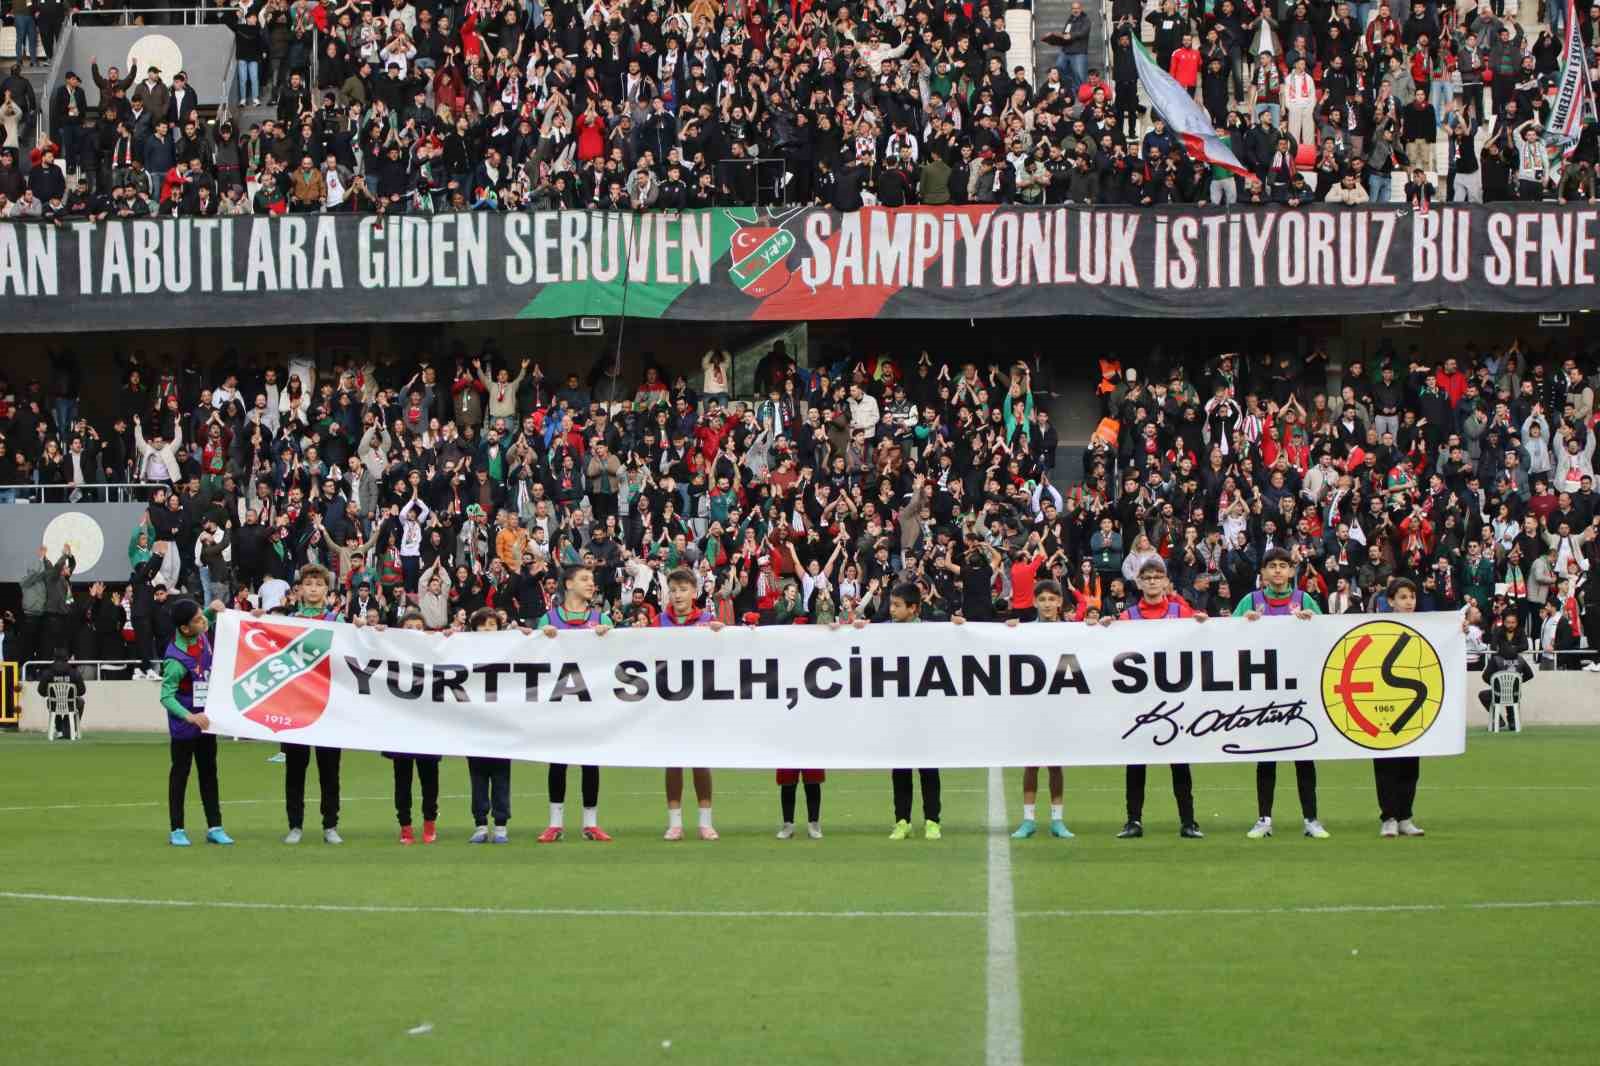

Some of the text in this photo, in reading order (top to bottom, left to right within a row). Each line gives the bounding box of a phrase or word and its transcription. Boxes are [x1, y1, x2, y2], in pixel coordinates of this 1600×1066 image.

[0, 222, 58, 296] AN
[72, 214, 344, 295] TABUTLARA
[358, 211, 488, 288] GİDEN
[1154, 211, 1396, 289] İSTİYORUZ
[1412, 209, 1471, 283] BU
[1484, 210, 1598, 287] SENE
[240, 642, 321, 700] K.S.K.
[344, 655, 592, 702] YURTTA
[1112, 649, 1298, 692] SULH.
[264, 714, 293, 726] 1912
